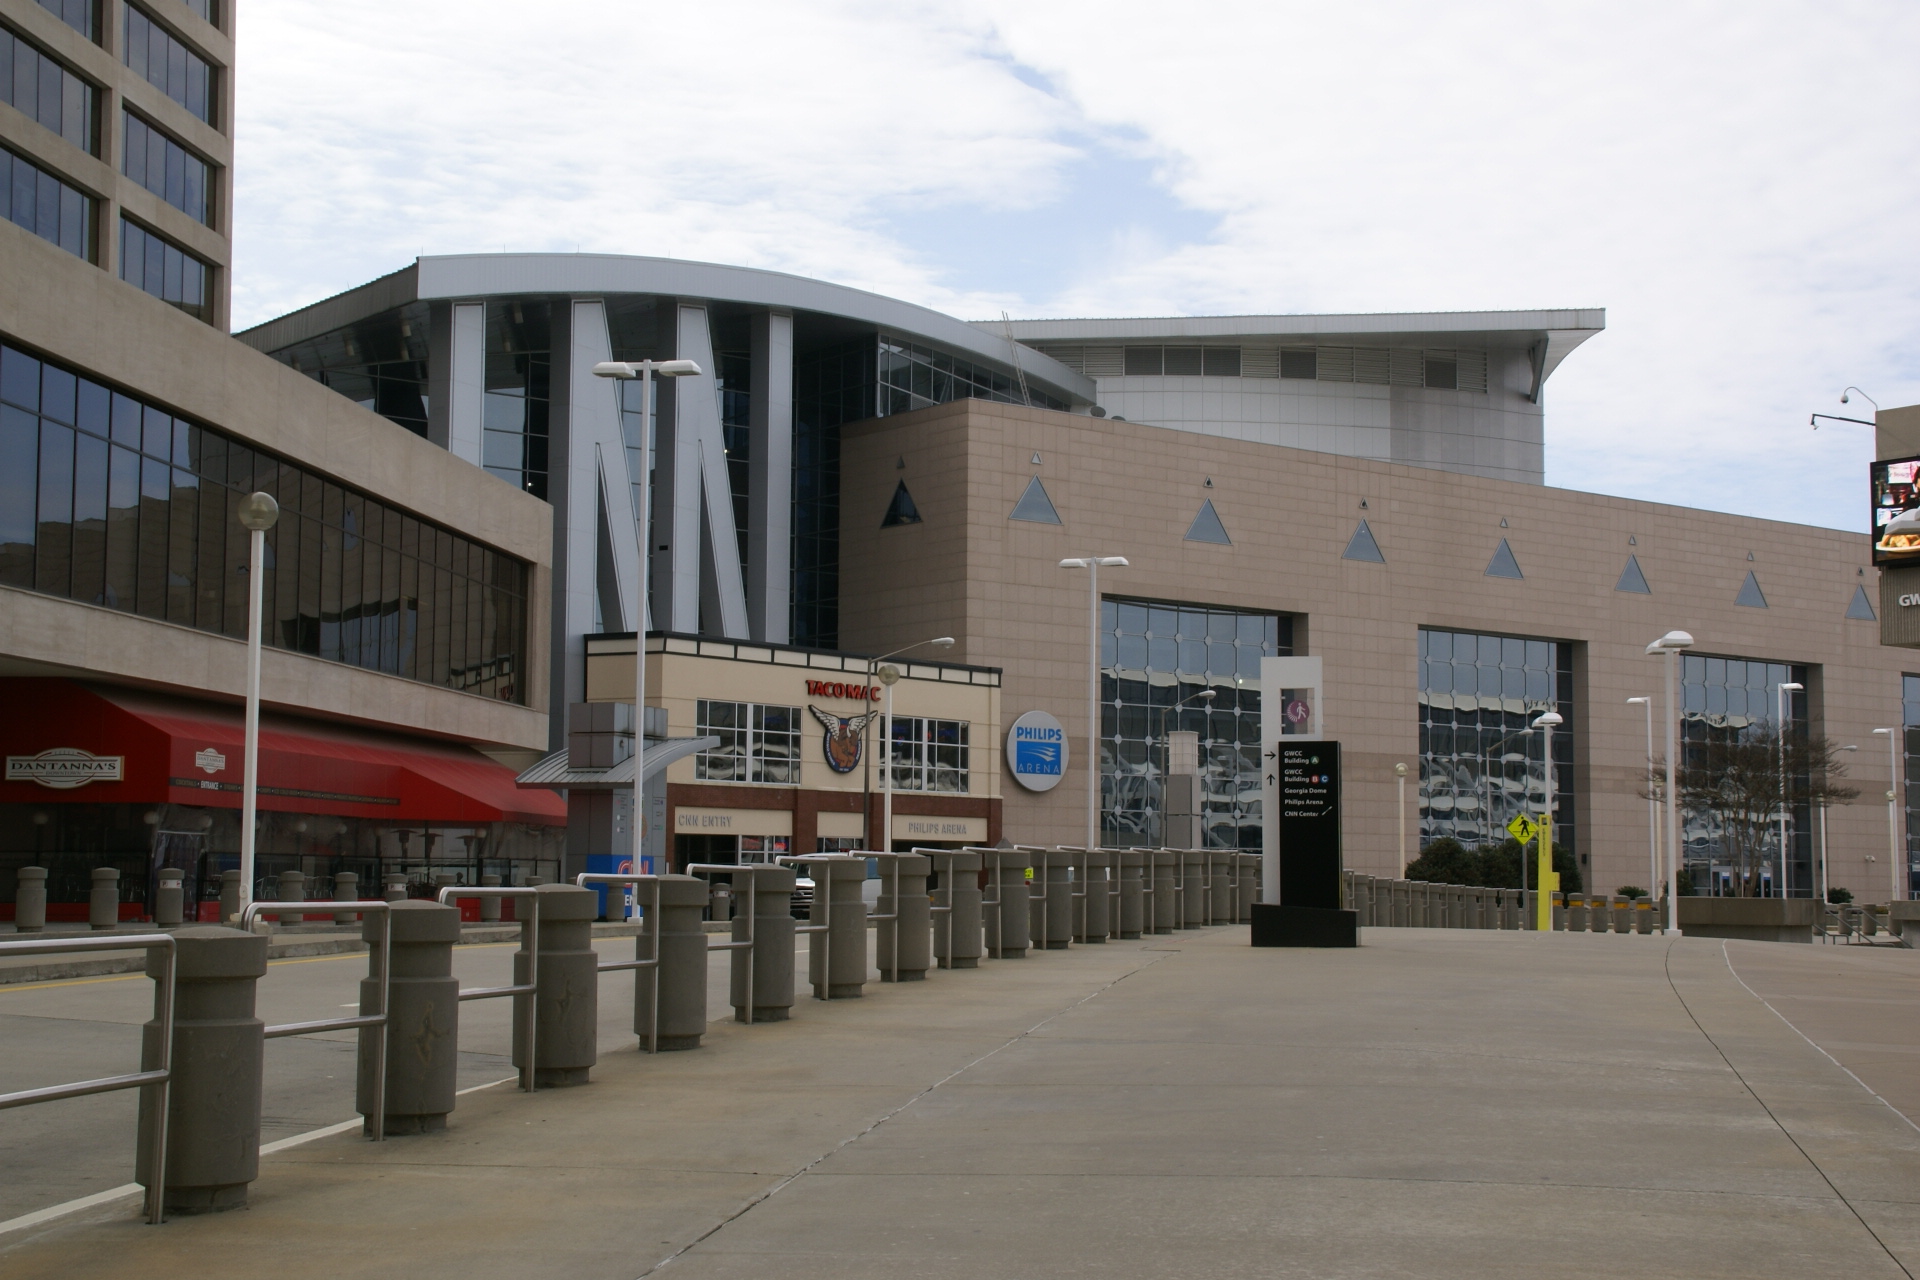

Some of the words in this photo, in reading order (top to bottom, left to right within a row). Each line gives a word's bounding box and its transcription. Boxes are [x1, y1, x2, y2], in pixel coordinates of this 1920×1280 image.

[1016, 726, 1062, 741] PHILIPS
[11, 762, 117, 771] DANTANNA'S
[1017, 763, 1060, 774] ARENA
[201, 780, 219, 790] ENTRANCE
[679, 814, 698, 827] CNN
[702, 815, 732, 828] ENTRY
[908, 822, 939, 834] PHILIPS
[941, 823, 967, 835] ARENA
